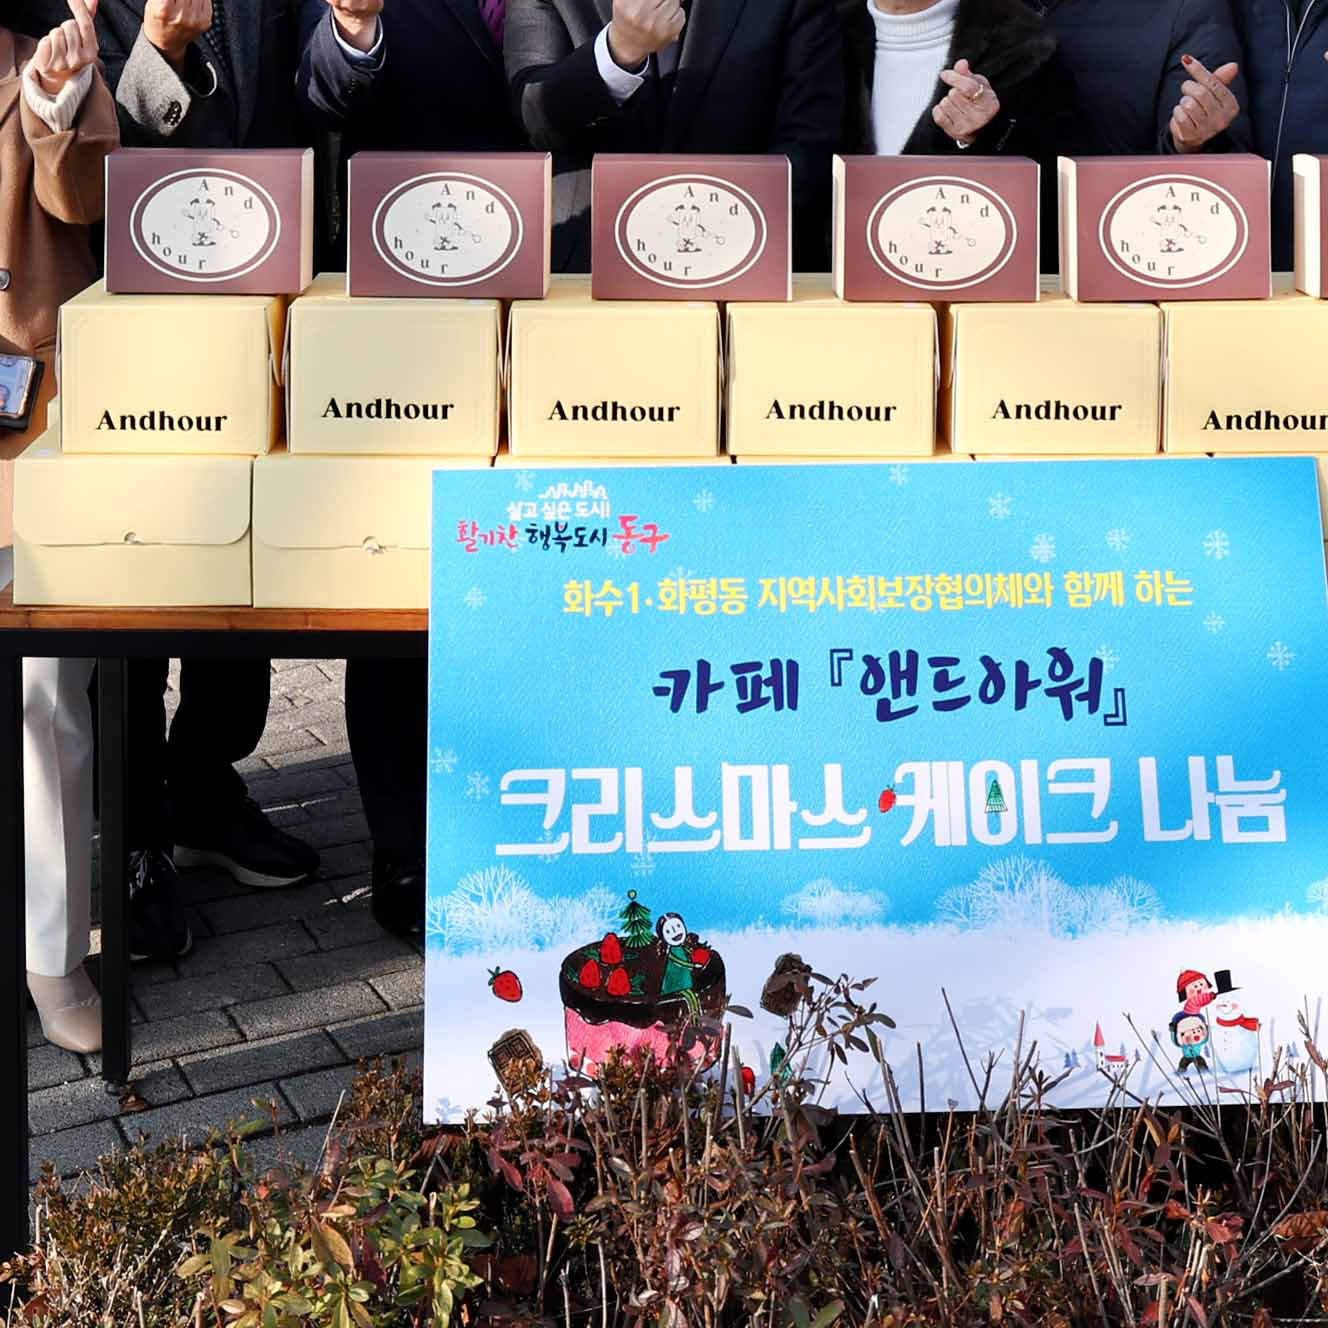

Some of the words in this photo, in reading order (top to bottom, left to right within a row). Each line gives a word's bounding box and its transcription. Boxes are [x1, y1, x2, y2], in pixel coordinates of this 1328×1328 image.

[96, 409, 228, 433] Andhour
[321, 397, 455, 421] Andhour
[547, 400, 681, 423] Andhour
[765, 399, 897, 422] Andhour
[992, 399, 1122, 422] Andhour
[541, 501, 571, 520] 싶은
[456, 520, 519, 553] 활기찬
[525, 521, 608, 553] 행복도시
[612, 515, 670, 554] 동구
[758, 571, 1054, 613] 지역사회보장협의체와
[1063, 570, 1125, 608] 함께
[1134, 570, 1194, 607] 하는
[652, 658, 800, 714] 카페
[495, 761, 872, 856] 크리스마스
[891, 758, 1119, 847] 케이크
[1138, 755, 1287, 844] 나눔
